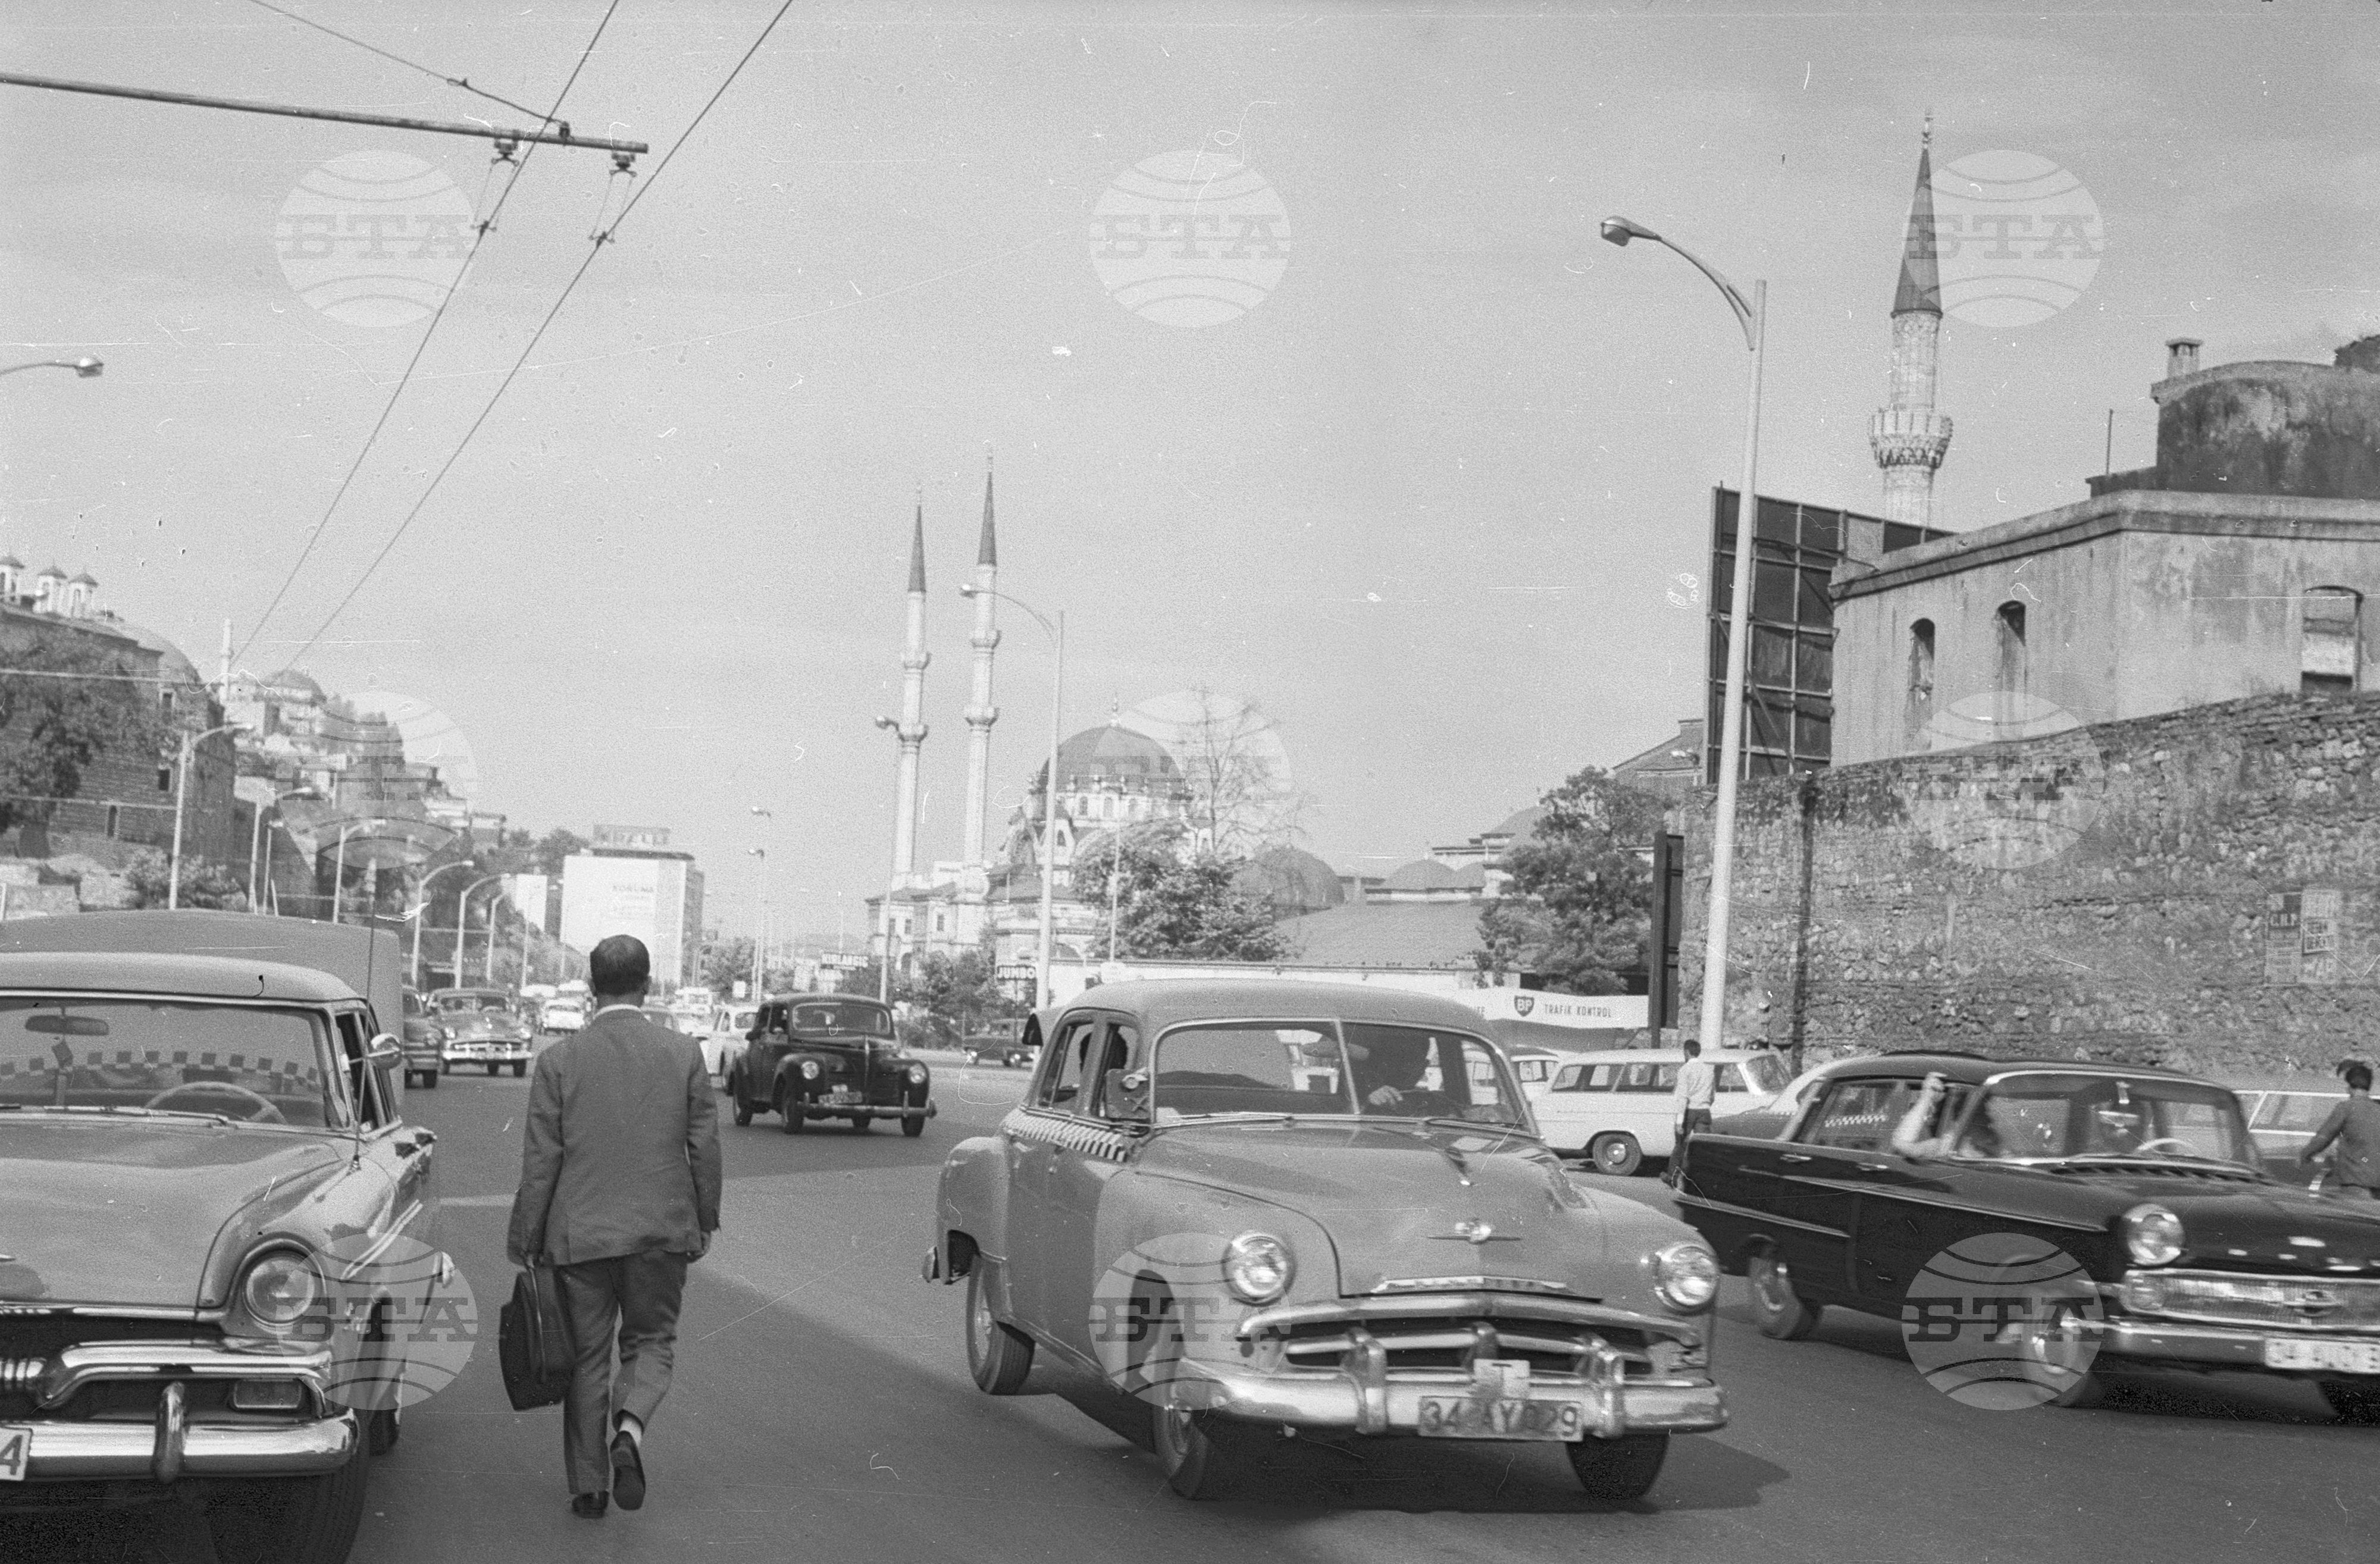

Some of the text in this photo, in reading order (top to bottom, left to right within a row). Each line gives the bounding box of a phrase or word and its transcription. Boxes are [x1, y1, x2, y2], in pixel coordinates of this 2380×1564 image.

[998, 967, 1035, 979] JUMBO
[1517, 998, 1532, 1011] BP
[1577, 1005, 1611, 1018] KONTROL
[1427, 1401, 1460, 1431] 34
